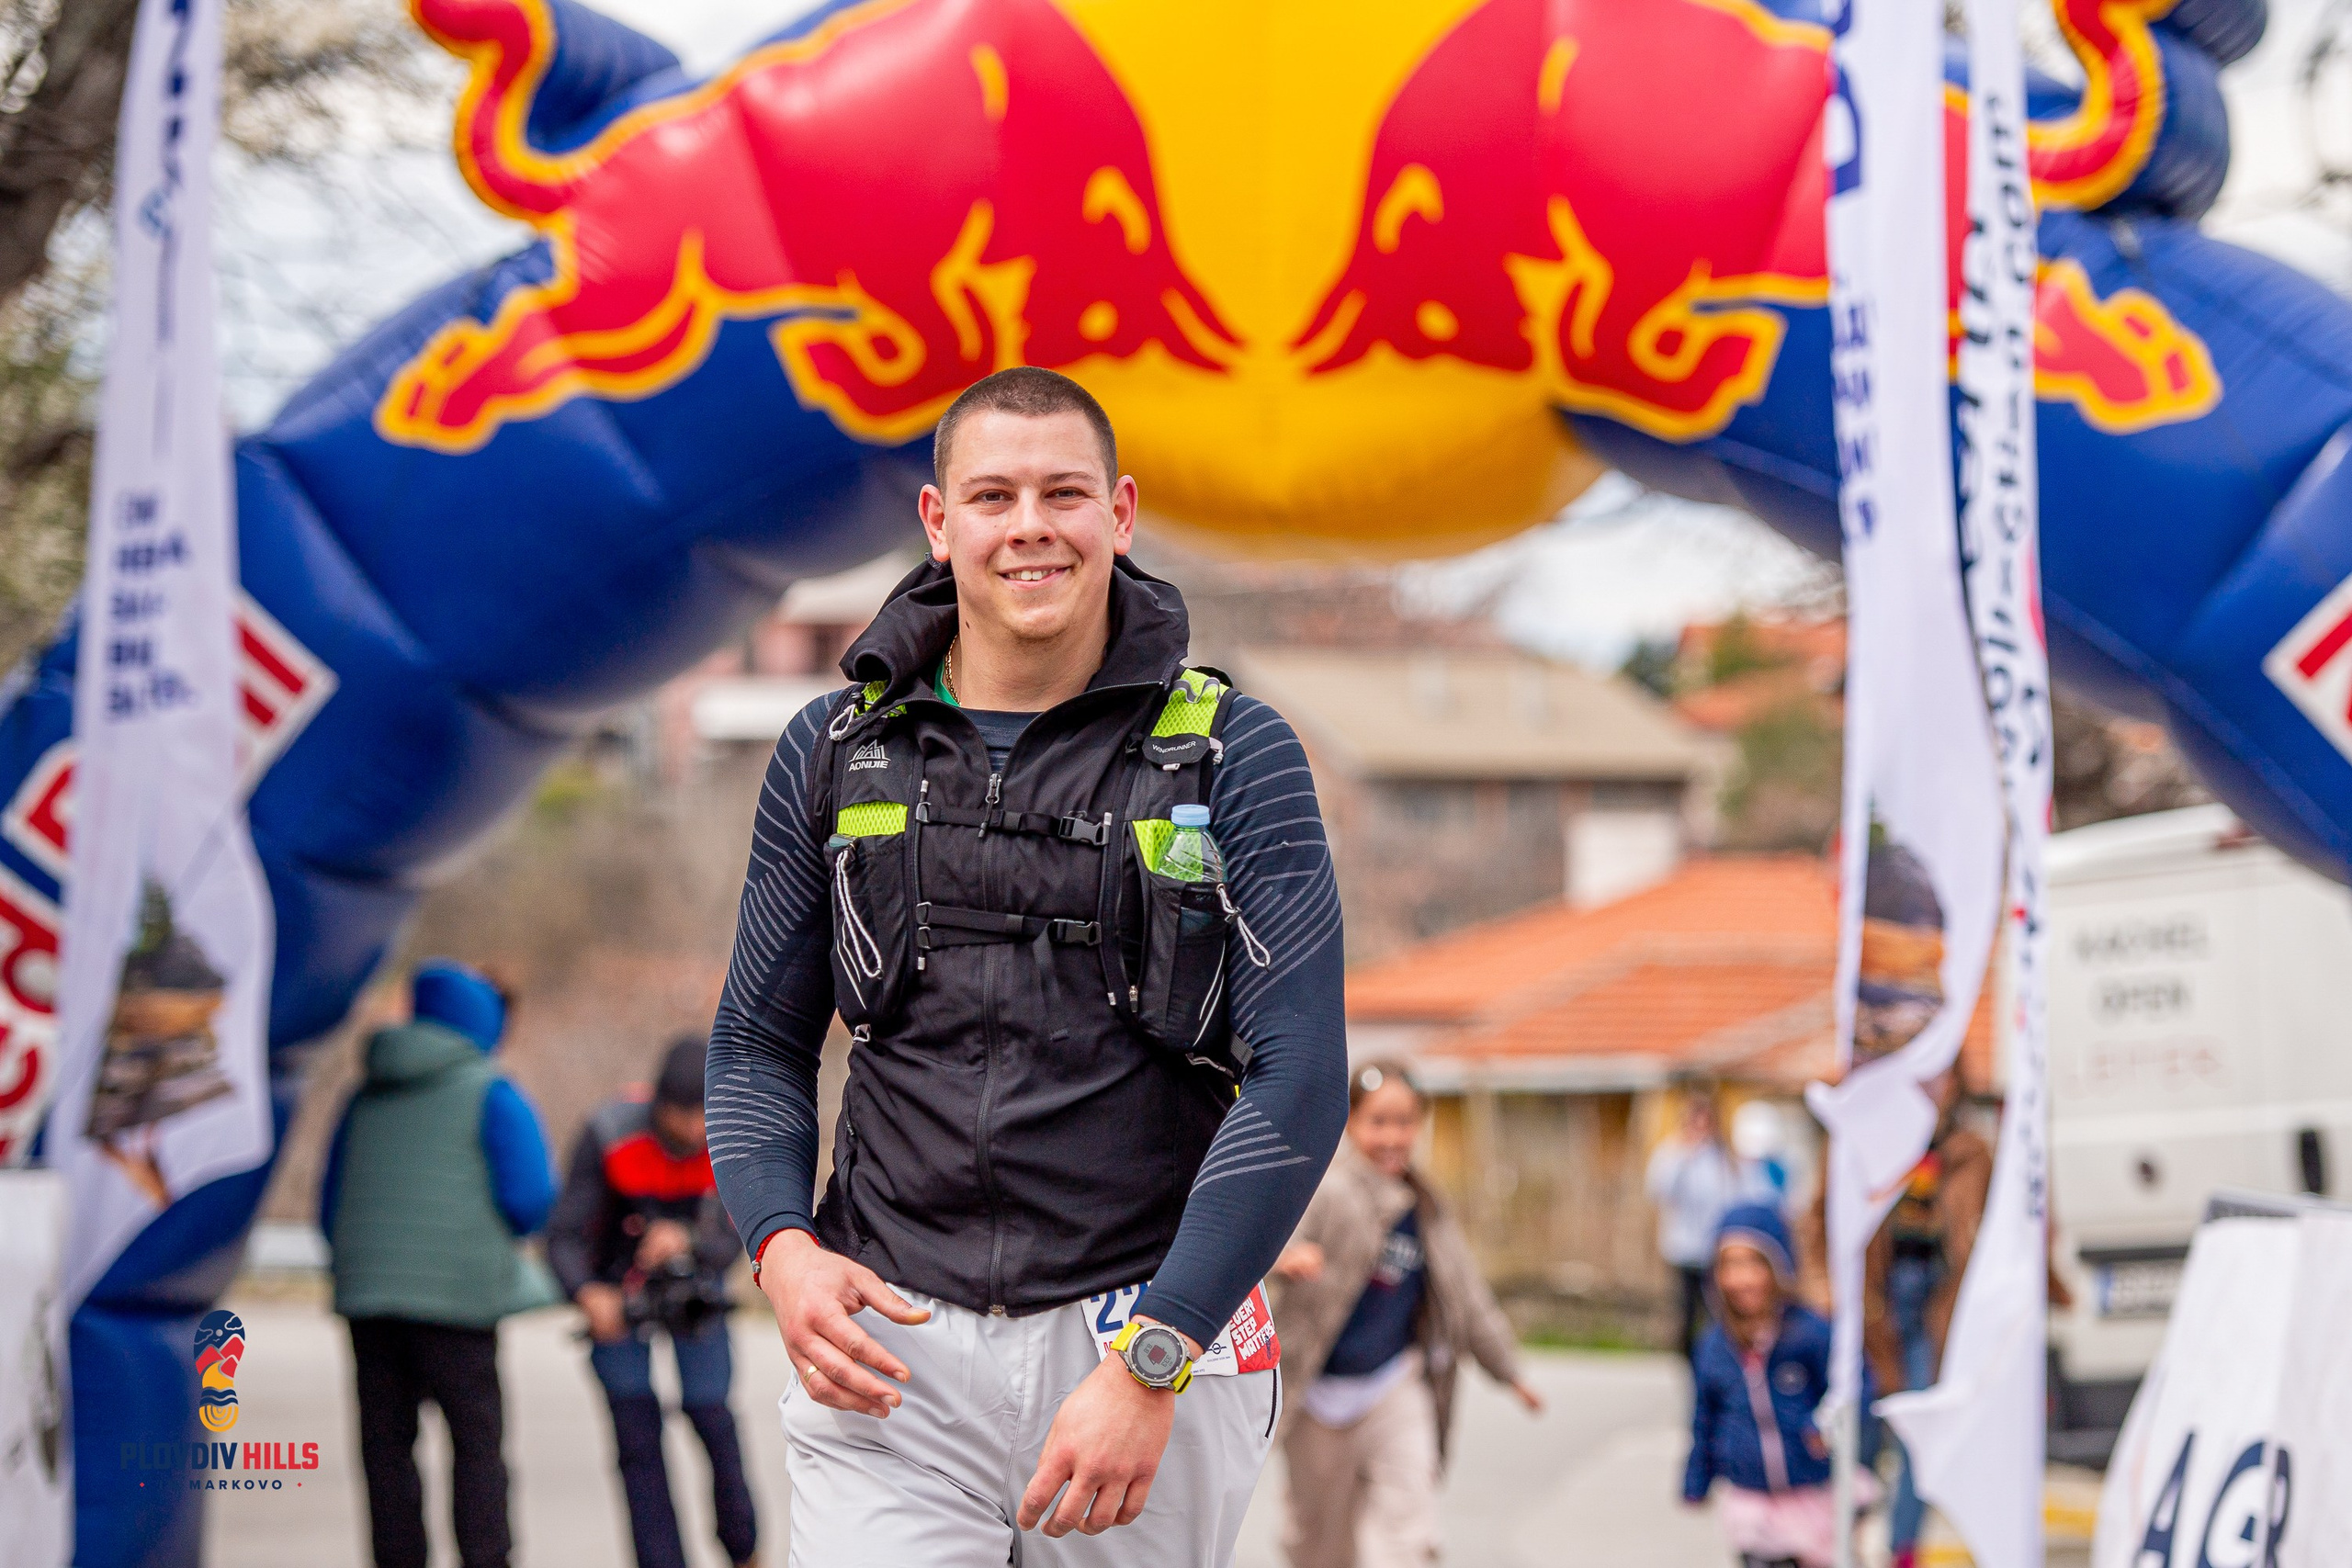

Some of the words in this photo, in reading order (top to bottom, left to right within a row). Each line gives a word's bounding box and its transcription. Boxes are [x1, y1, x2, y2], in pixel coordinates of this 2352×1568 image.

[1152, 740, 1196, 753] WINDRUNNER
[848, 760, 889, 772] AONIJIE
[1229, 1296, 1256, 1331] EVERY
[1231, 1315, 1258, 1346] STEP
[1238, 1319, 1276, 1361] MATTERS
